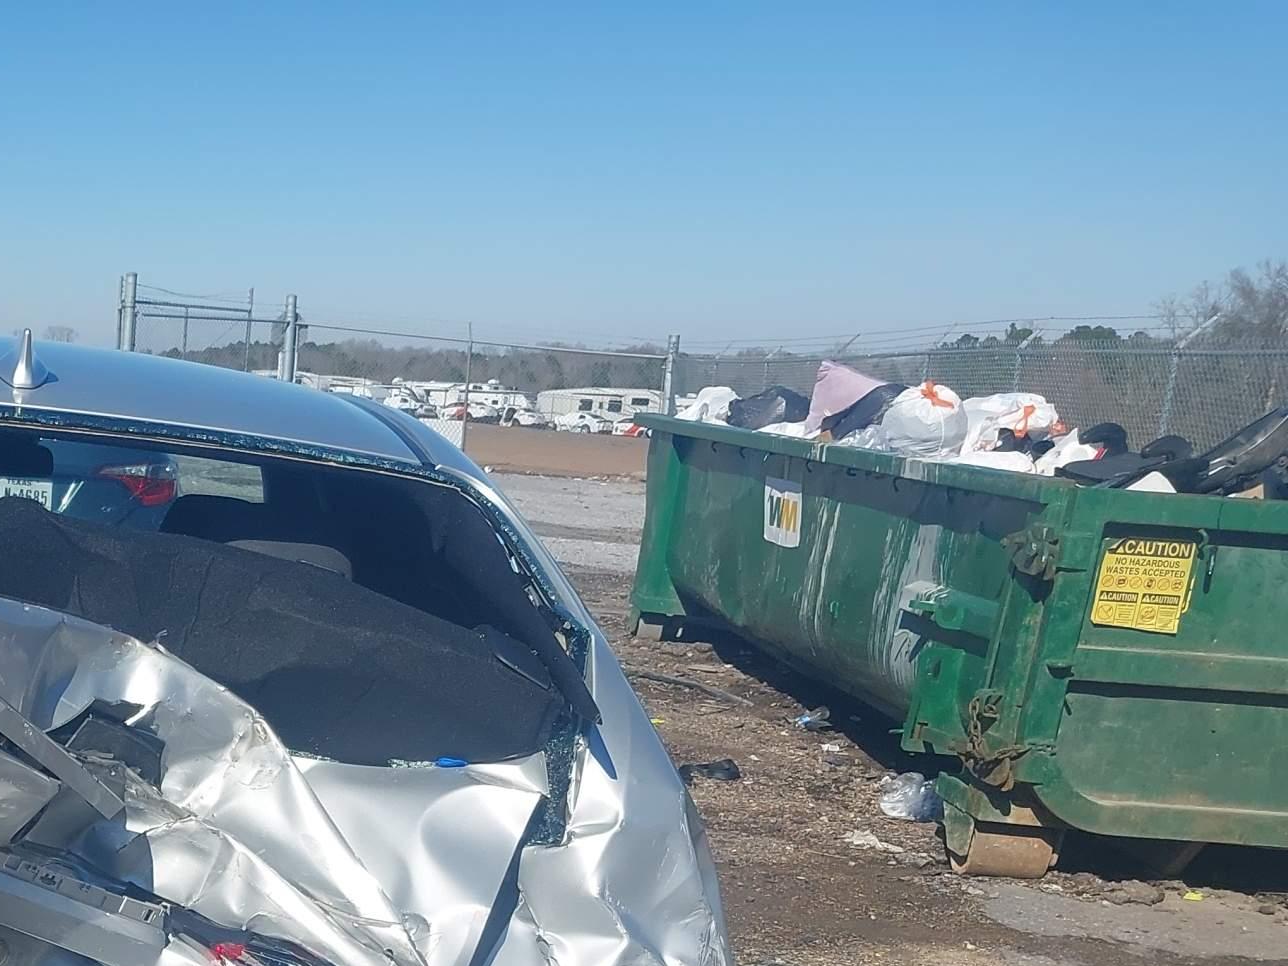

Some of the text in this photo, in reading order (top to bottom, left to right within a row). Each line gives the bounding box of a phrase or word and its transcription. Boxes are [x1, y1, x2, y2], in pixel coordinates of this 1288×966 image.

[768, 494, 798, 532] WM
[1125, 540, 1192, 558] CAUTION
[1114, 557, 1181, 569] NO HAZARDOUS
[1106, 566, 1186, 579] WASTES ACCEPTED
[1107, 592, 1138, 602] CAUTION
[1149, 595, 1179, 605] CAUTION
